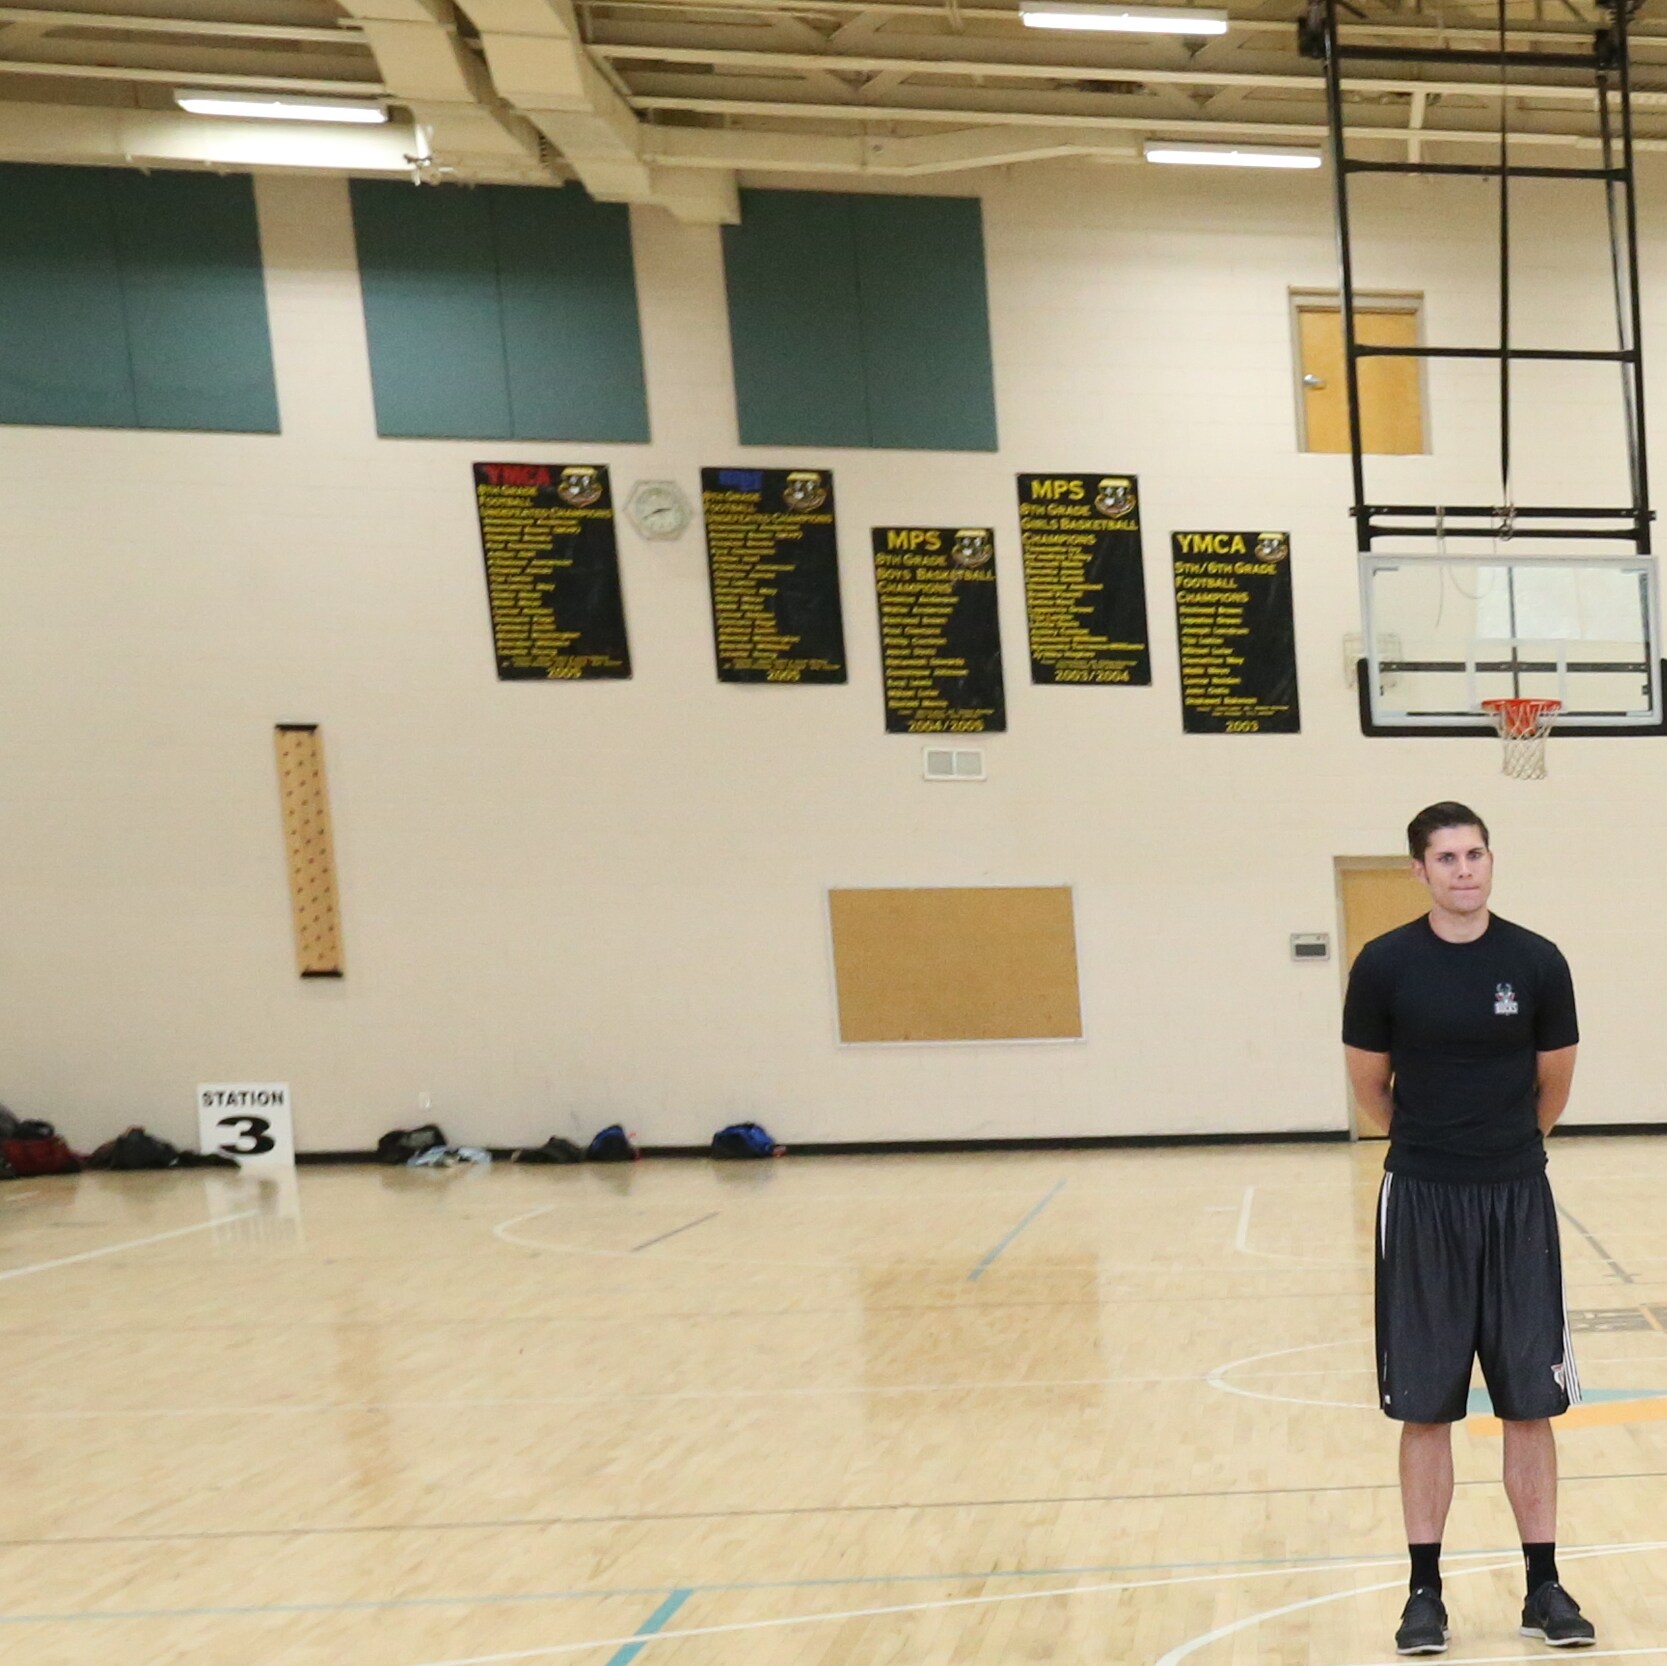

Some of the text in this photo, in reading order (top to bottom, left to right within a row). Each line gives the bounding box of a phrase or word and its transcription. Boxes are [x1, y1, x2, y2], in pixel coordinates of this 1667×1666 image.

[1031, 479, 1086, 500] MPS
[1059, 518, 1139, 531] BASKETBALL
[886, 529, 942, 551] MPS
[1022, 532, 1097, 546] CHAMPIONS
[1176, 533, 1247, 555] YMCA
[915, 568, 996, 582] BASKETBALL
[1233, 562, 1278, 575] GRADE
[1174, 575, 1238, 589] FOOTBALL
[1176, 590, 1250, 604] CHAMPIONS
[202, 1089, 284, 1108] STATION
[216, 1115, 276, 1155] 3
